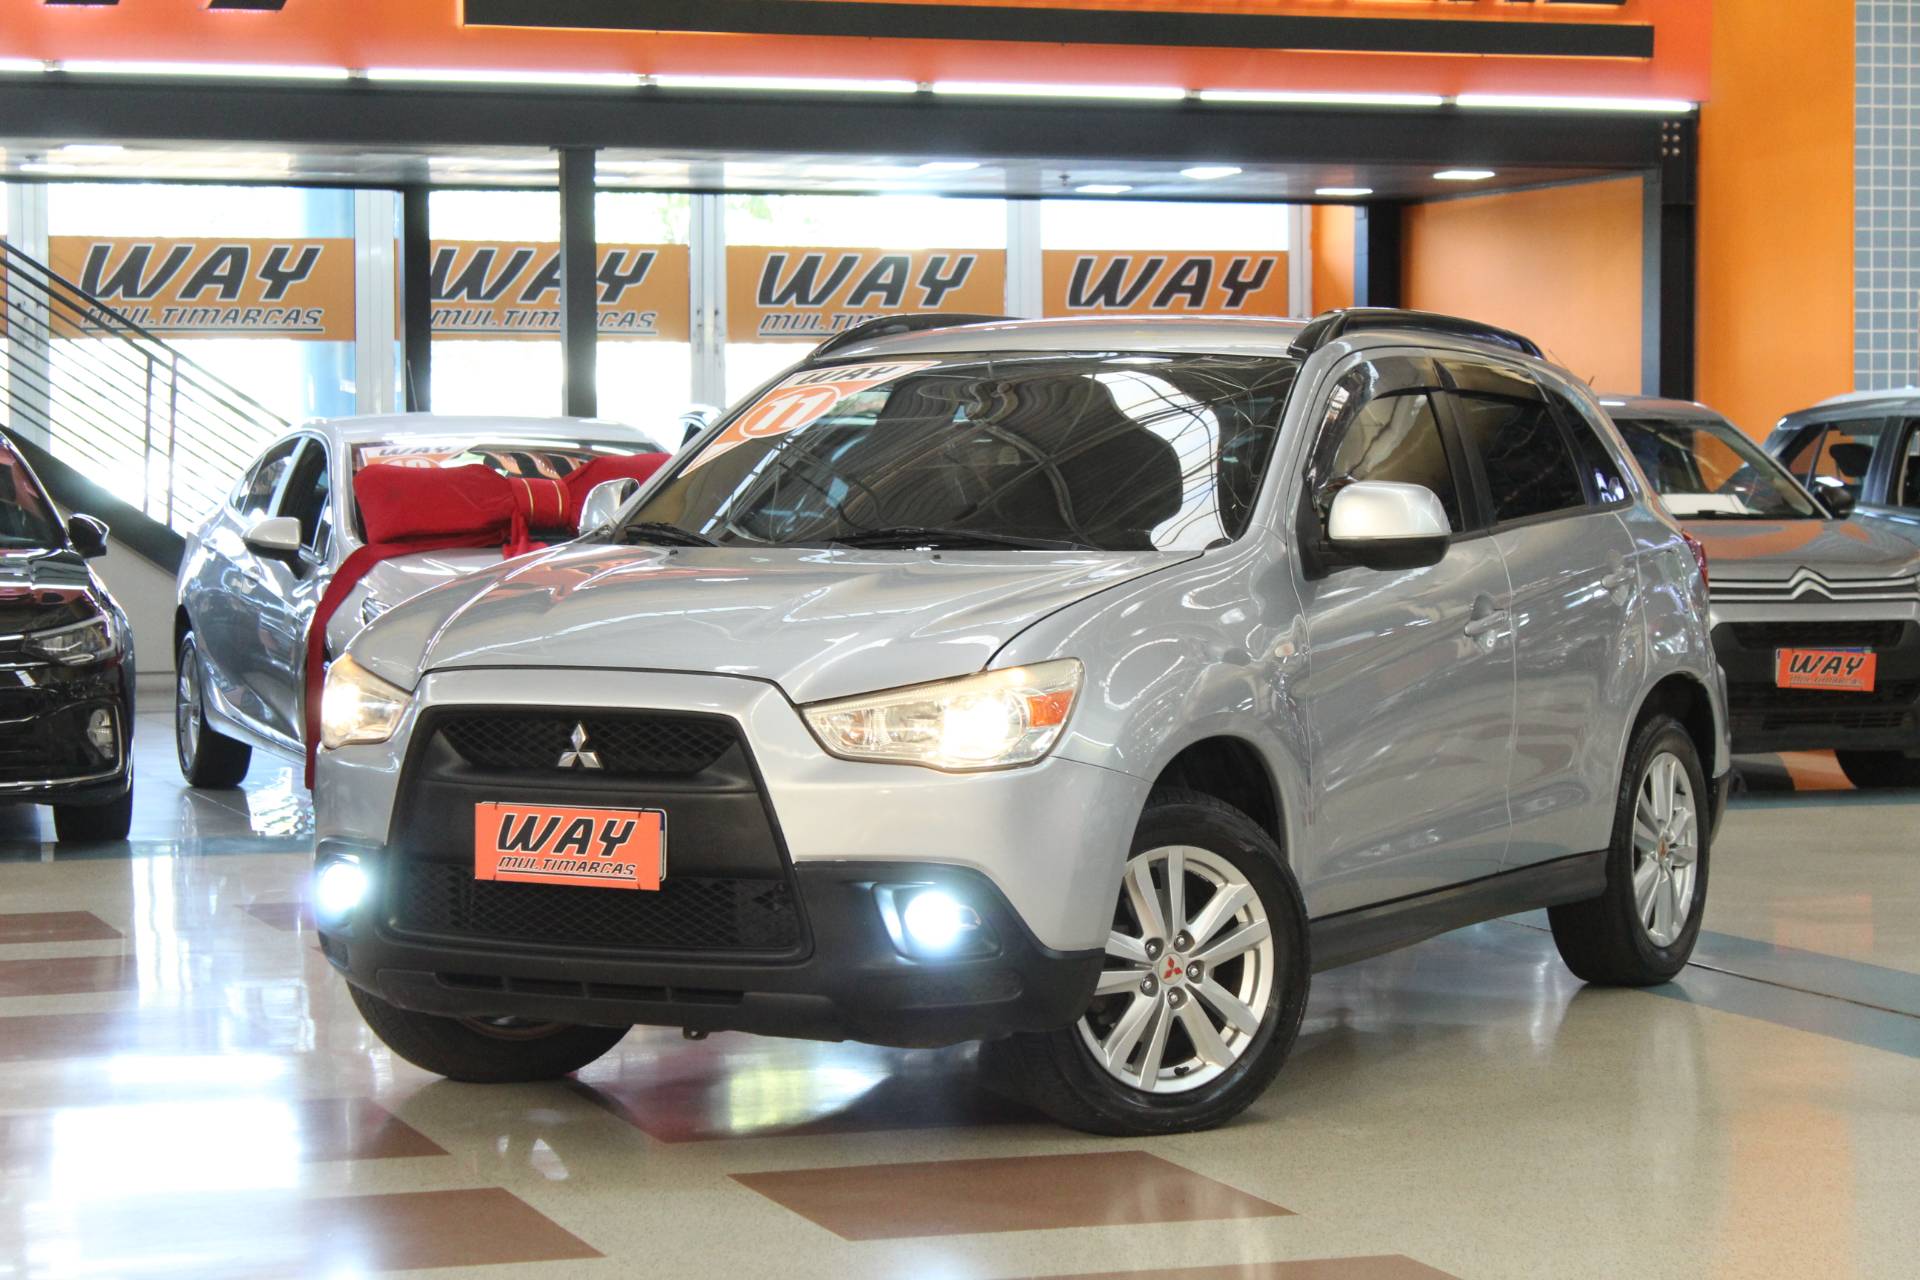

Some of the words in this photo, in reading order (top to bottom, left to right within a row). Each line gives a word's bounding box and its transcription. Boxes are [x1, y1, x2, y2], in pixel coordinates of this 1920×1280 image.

[80, 244, 322, 301] WAY
[757, 253, 976, 308] WAY
[1067, 256, 1277, 309] WAY
[431, 309, 657, 328] MULTIMCAS
[794, 365, 902, 386] WAY
[750, 391, 834, 431] 11
[1789, 653, 1865, 676] WAY
[496, 812, 637, 858] WAY
[498, 856, 636, 876] MULTIMARCAS
